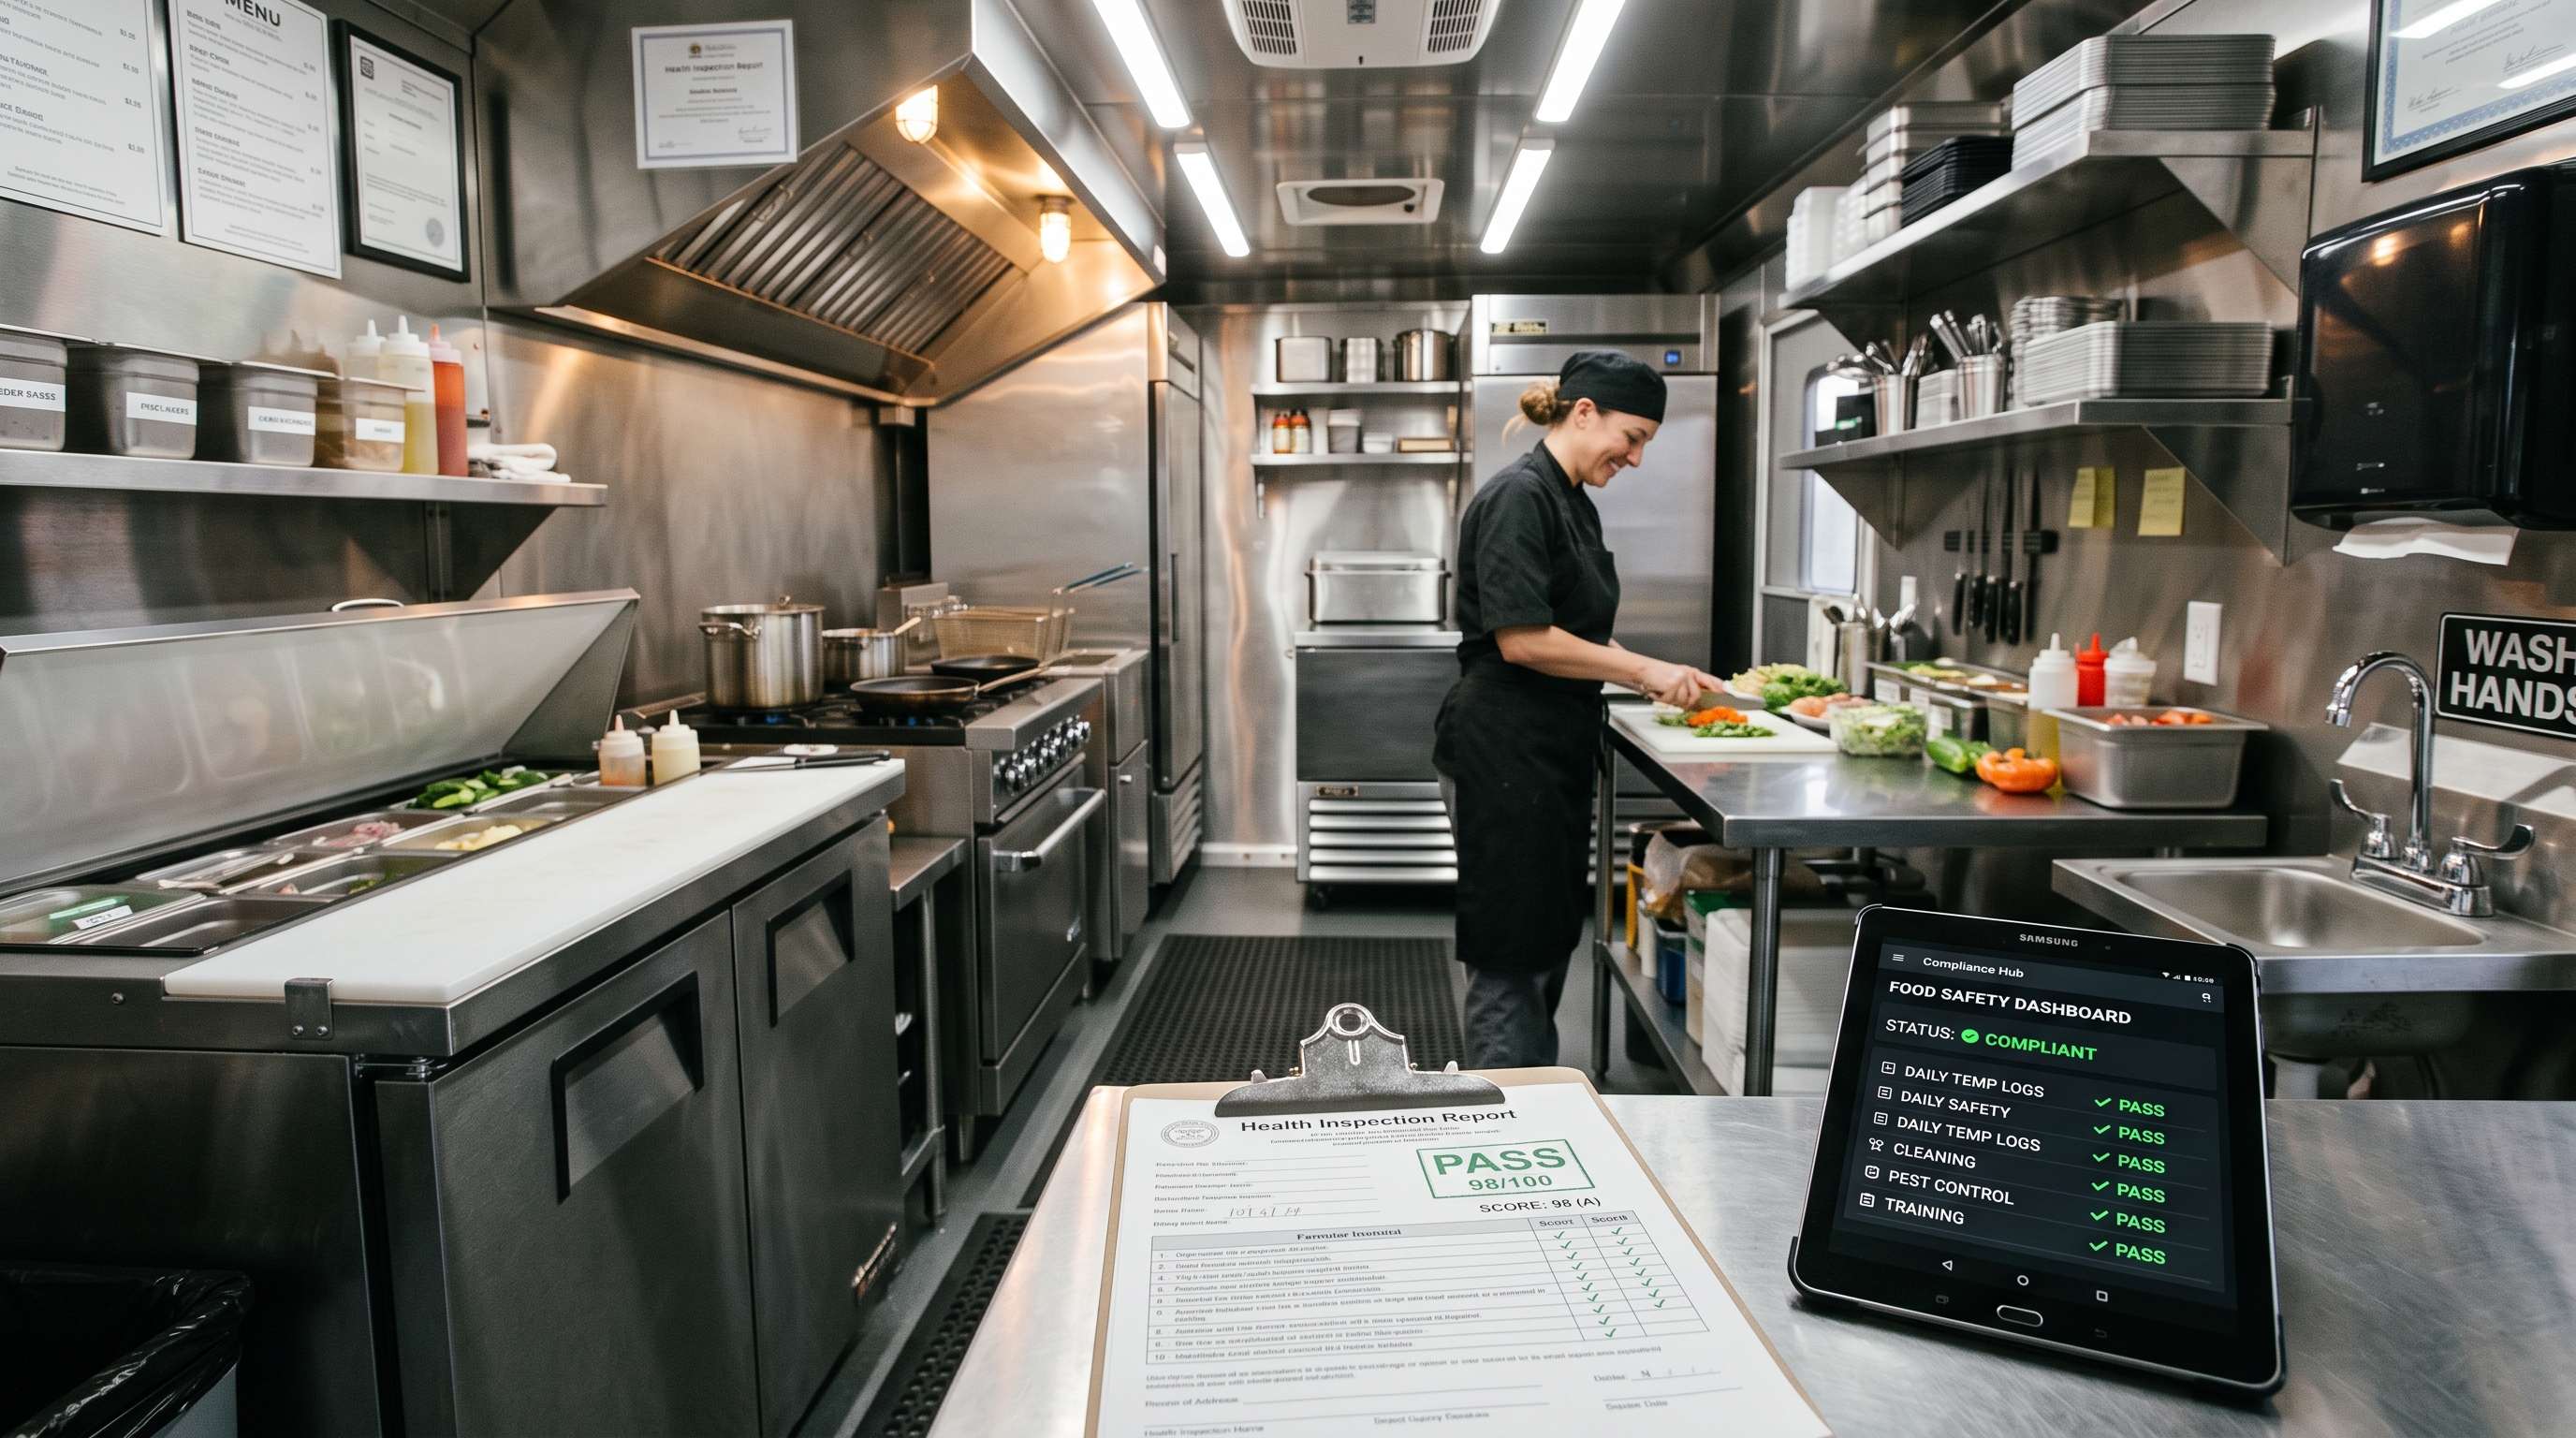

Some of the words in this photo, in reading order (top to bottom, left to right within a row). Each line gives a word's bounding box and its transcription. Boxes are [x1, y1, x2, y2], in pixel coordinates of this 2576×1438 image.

[26, 390, 56, 401] SASSS
[2465, 628, 2576, 675] WASH
[2019, 933, 2079, 947] SAMSUNG
[1923, 957, 1996, 974] Compliance
[1998, 966, 2024, 978] Hub
[1889, 981, 1936, 998] FOOD
[1940, 988, 2011, 1008] SAFETY
[2014, 998, 2131, 1024] DASHBOARD
[1885, 1019, 1955, 1040] STATUS:
[1985, 1033, 2098, 1061] COMPLIANT
[1905, 1065, 1949, 1082] DAILY
[1952, 1072, 1998, 1090] TEMP
[2001, 1080, 2044, 1098] LOGS
[1900, 1091, 1945, 1108] DAILY
[1948, 1098, 2012, 1119] SAFETY
[2119, 1099, 2165, 1117] PASS
[1241, 1120, 1311, 1132] Health
[1319, 1113, 1435, 1129] Inspection
[1442, 1109, 1517, 1123] Report
[1896, 1116, 1942, 1134] DAILY
[1945, 1124, 1992, 1143] TEMP
[1996, 1134, 2042, 1152] LOGS
[2118, 1126, 2165, 1145] PASS
[1433, 1147, 1566, 1176] PASS
[1894, 1142, 1976, 1168] CLEANING
[2118, 1154, 2165, 1174] PASS
[1468, 1175, 1553, 1191] 98/100
[1888, 1170, 1931, 1189] PEST
[1934, 1179, 2014, 1206] CONTROL
[2117, 1182, 2166, 1203] PASS
[1479, 1199, 1547, 1213] SCORE:
[1551, 1198, 1572, 1209] 98
[1576, 1197, 1602, 1208] (A)
[1884, 1197, 1965, 1225] TRAINING
[2116, 1212, 2166, 1234] PASS
[2115, 1242, 2166, 1265] PASS
